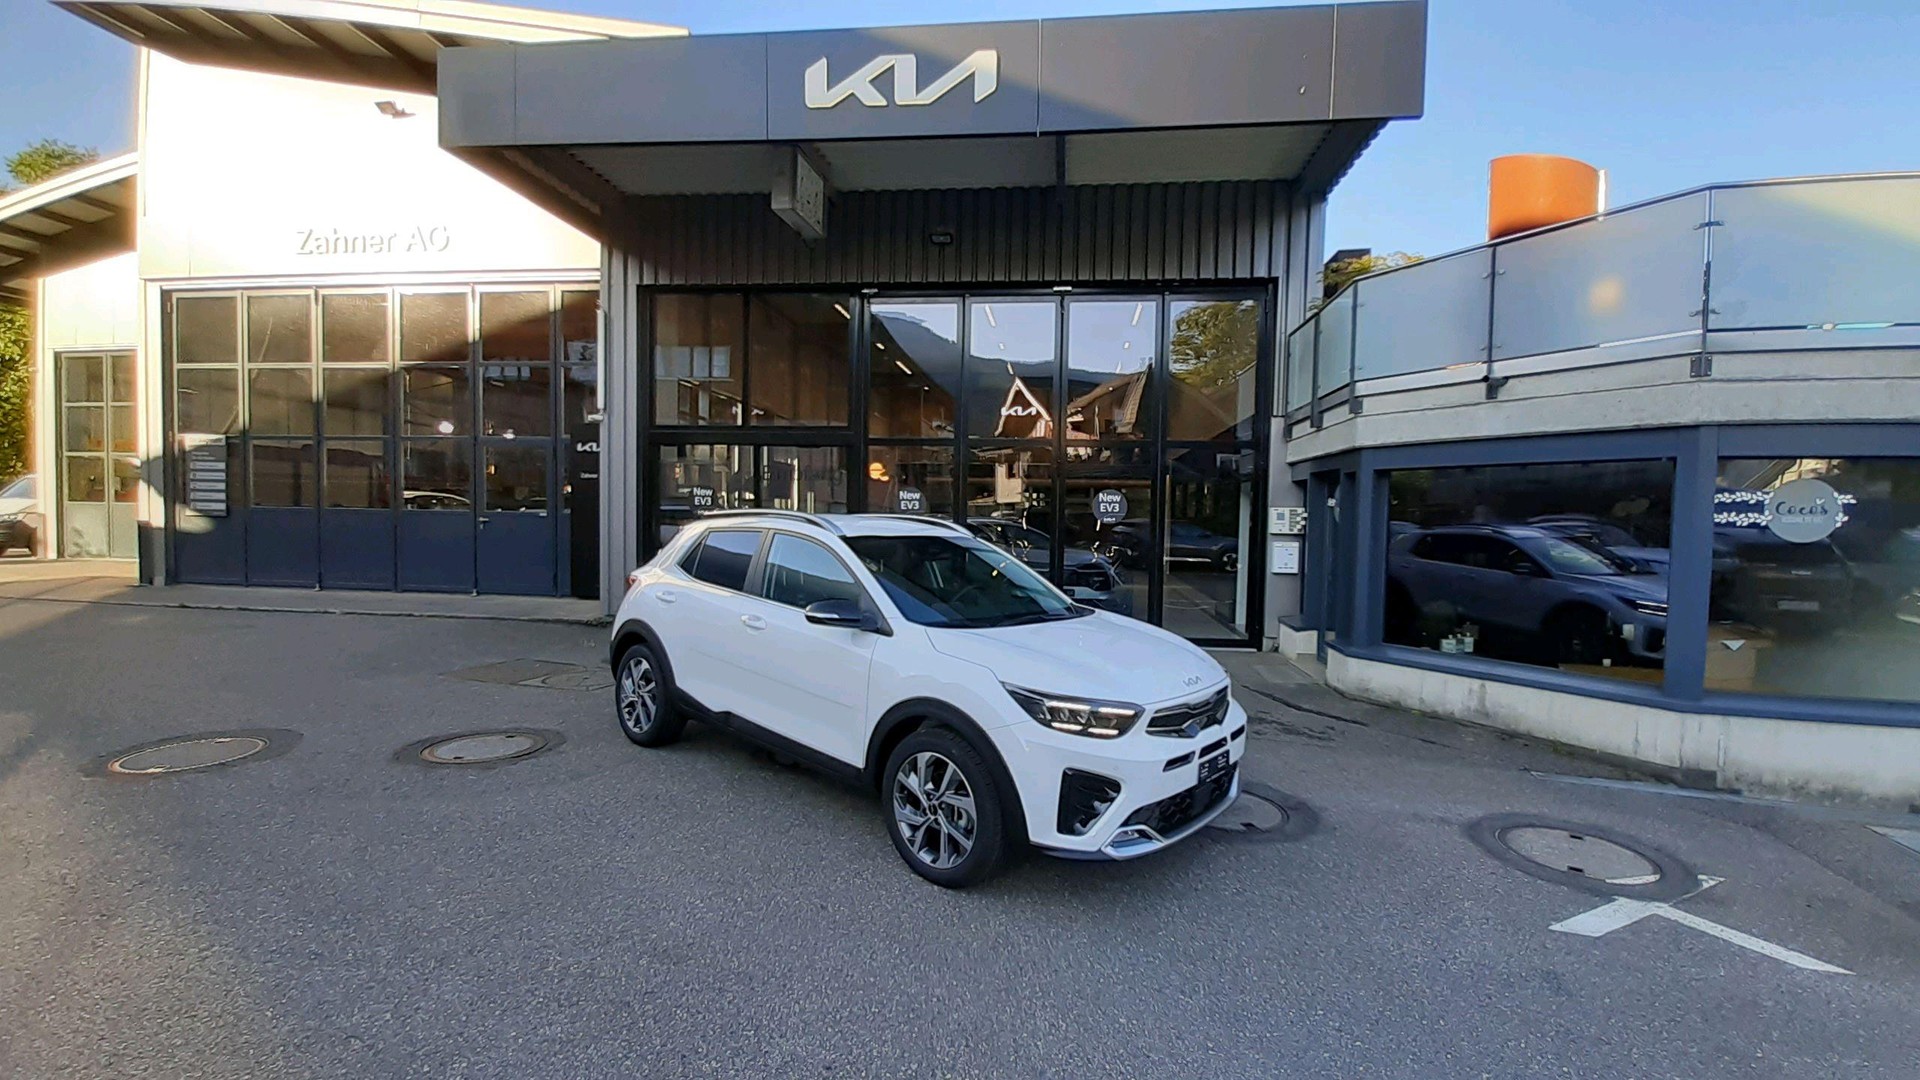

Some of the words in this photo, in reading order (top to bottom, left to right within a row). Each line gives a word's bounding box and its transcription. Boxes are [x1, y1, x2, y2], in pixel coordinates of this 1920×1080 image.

[805, 50, 998, 108] KIA
[297, 228, 397, 254] Zahner
[406, 225, 450, 252] AG
[693, 487, 714, 496] New
[899, 490, 921, 500] New
[694, 497, 712, 506] EV3
[1099, 492, 1122, 502] New
[900, 500, 920, 510] EV3
[1100, 503, 1120, 512] EV3
